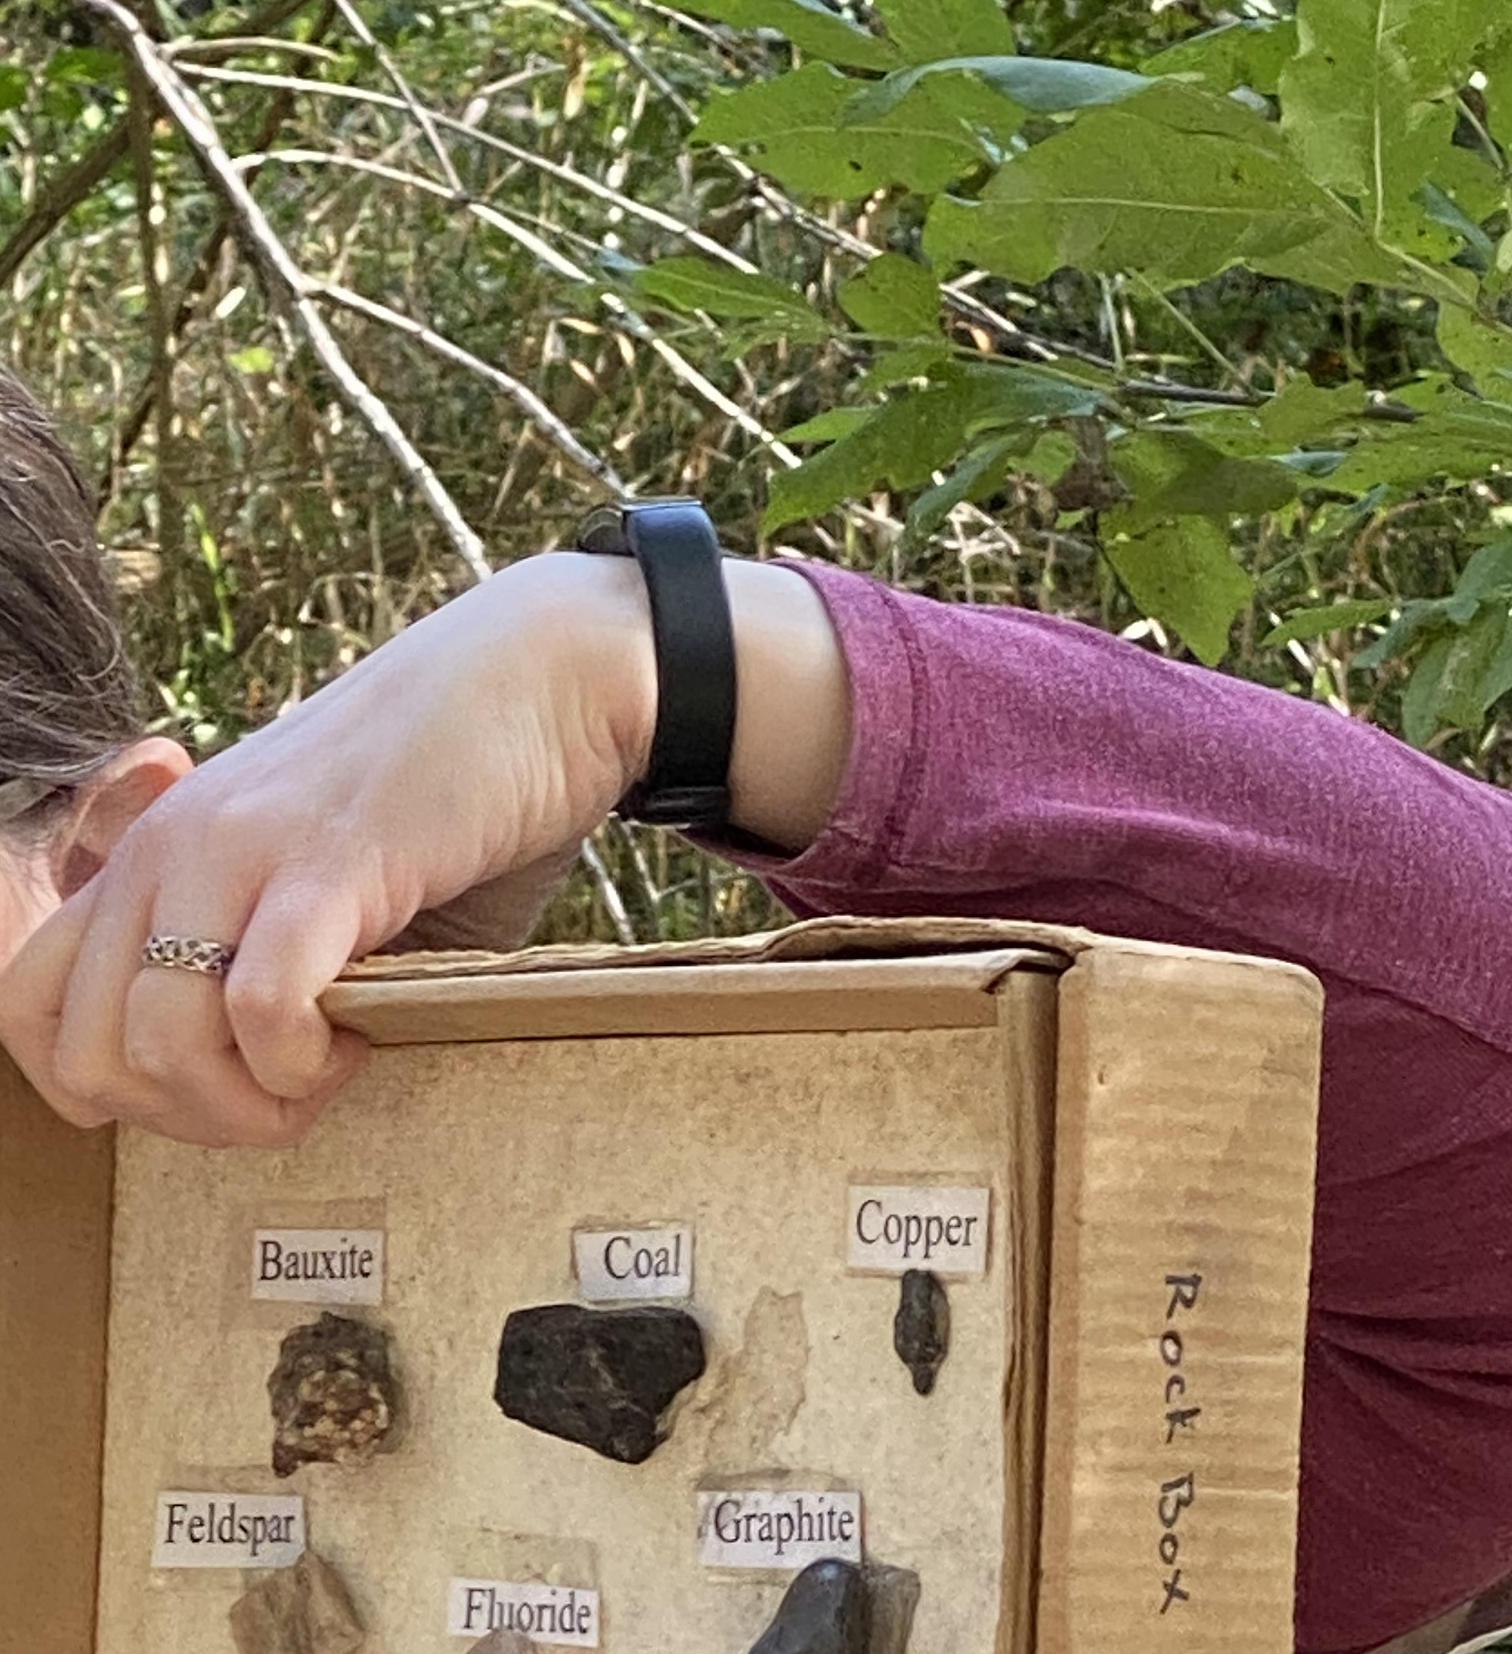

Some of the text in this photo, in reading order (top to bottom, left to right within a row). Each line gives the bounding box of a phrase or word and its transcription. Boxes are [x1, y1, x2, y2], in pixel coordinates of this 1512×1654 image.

[855, 1198, 979, 1260] Copper
[257, 1236, 374, 1281] Bauxite
[604, 1233, 682, 1279] Coal
[163, 1501, 295, 1557] Feldspar
[713, 1496, 855, 1556] Graphite
[462, 1586, 592, 1634] Fluoride
